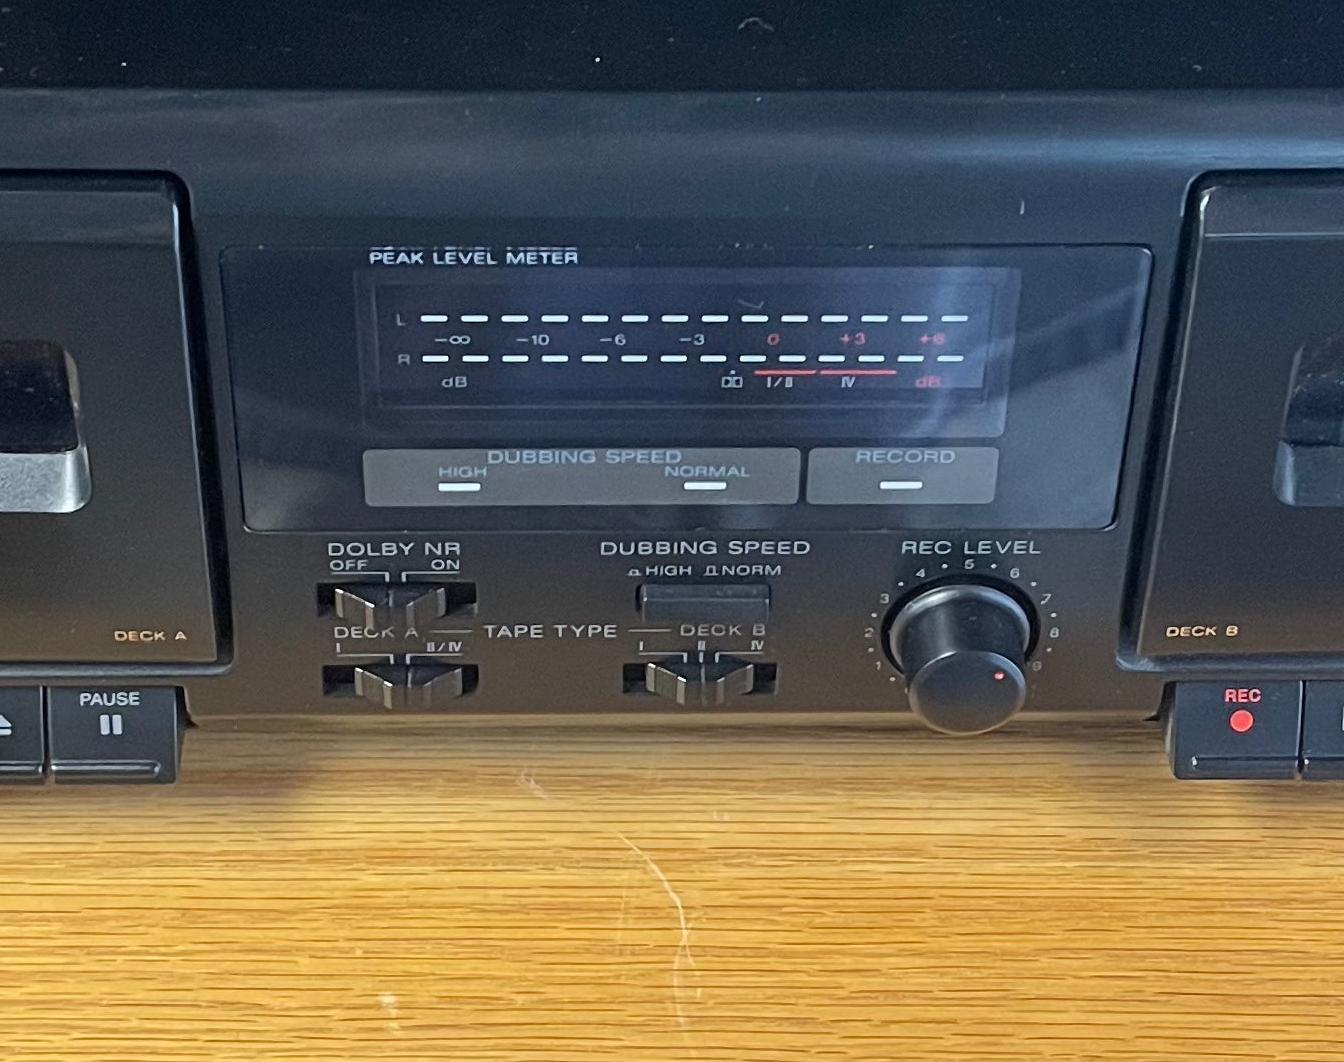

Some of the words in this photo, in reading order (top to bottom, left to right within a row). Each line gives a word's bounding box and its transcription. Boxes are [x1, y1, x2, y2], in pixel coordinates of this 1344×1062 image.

[369, 250, 424, 265] PEAK
[433, 250, 497, 265] LEVEL
[506, 250, 578, 265] METER
[395, 314, 406, 326] L
[398, 354, 410, 366] R
[442, 376, 468, 388] dB
[487, 450, 596, 465] DUBBING
[604, 449, 683, 464] SPEED
[856, 449, 956, 465] RECORD
[438, 466, 488, 478] HIGH
[664, 465, 750, 478] NORMAL
[327, 542, 415, 556] DOLBY
[425, 542, 461, 556] NR
[600, 541, 718, 556] DUBBING
[728, 540, 811, 555] SPEED
[901, 540, 952, 555] REC
[963, 540, 1041, 555] LEVEL
[329, 559, 369, 571] OFF
[430, 559, 461, 571] ON
[964, 559, 975, 570] 5
[645, 565, 692, 577] HIGH
[722, 565, 782, 576] NORM
[915, 568, 926, 578] 4
[1009, 568, 1020, 579] 6
[880, 593, 890, 604] 3
[1040, 593, 1052, 605] 7
[114, 630, 166, 642] DECK
[174, 630, 188, 642] A
[334, 626, 396, 639] DECK
[404, 626, 419, 639] A
[483, 624, 544, 638] TAPE
[553, 624, 618, 638] TYPE
[680, 624, 742, 637] DECK
[752, 624, 766, 636] B
[864, 627, 874, 638] 2
[1049, 627, 1060, 638] 8
[1165, 625, 1217, 637] DECK
[1225, 624, 1239, 637] B
[80, 692, 141, 706] PAUSE
[1224, 689, 1261, 703] REC
